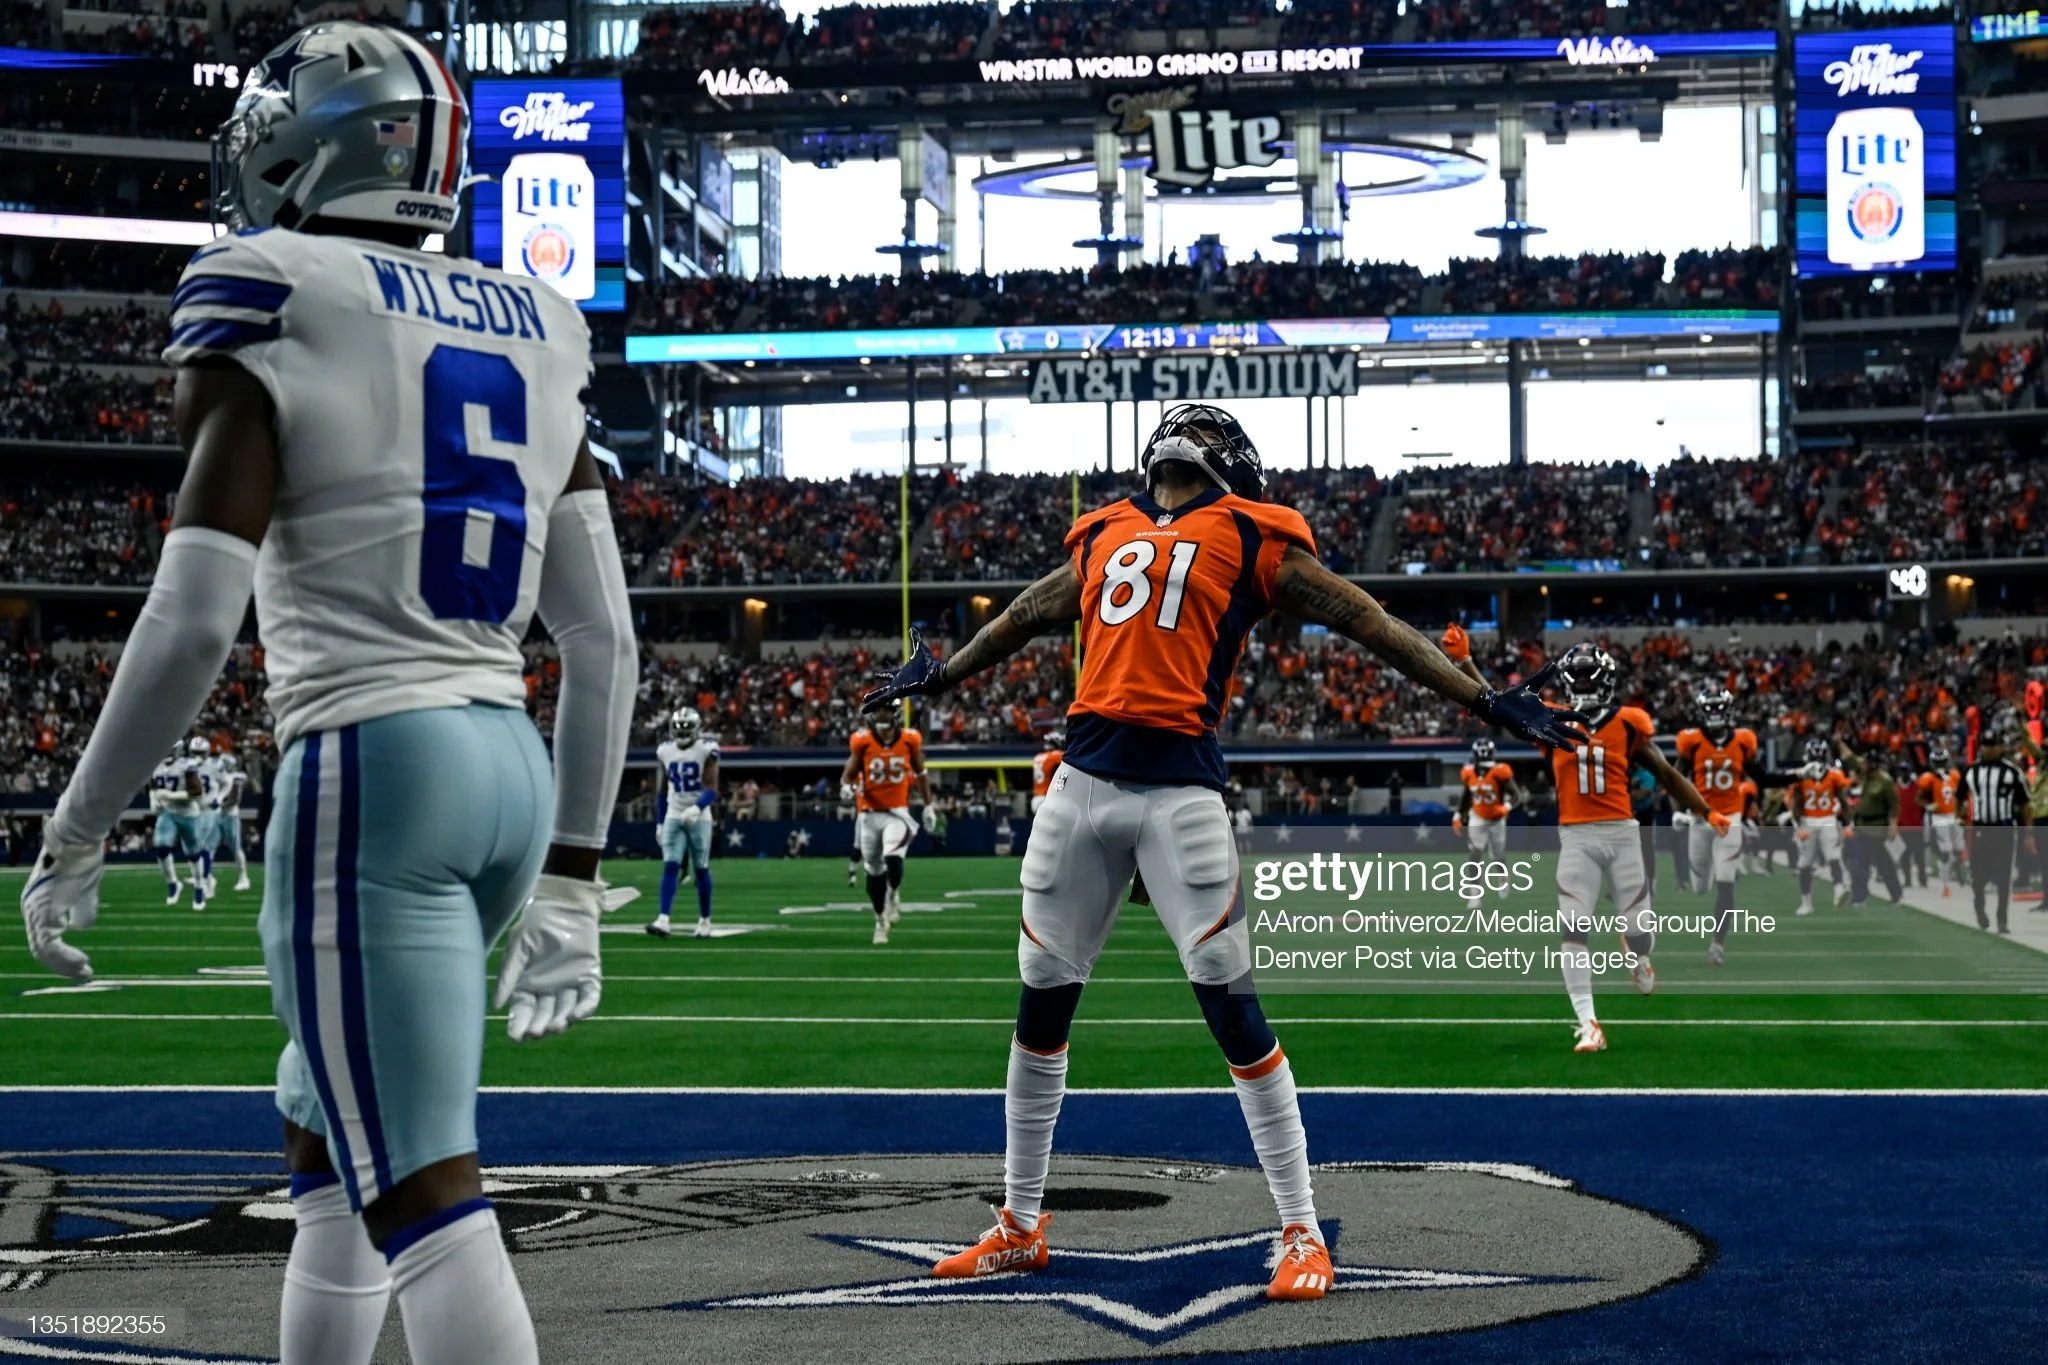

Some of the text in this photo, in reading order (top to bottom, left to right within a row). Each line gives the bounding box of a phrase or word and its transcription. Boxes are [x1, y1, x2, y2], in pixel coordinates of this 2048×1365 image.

[1980, 11, 2041, 41] TIME
[193, 63, 240, 89] IT'S
[979, 60, 1073, 82] WINSTAR
[1076, 56, 1153, 78] WORLD
[1157, 52, 1238, 76] CASINO
[1281, 47, 1364, 72] RESORT
[1144, 108, 1281, 186] Lite
[1841, 134, 1910, 175] Lite
[516, 177, 583, 216] Lite
[363, 254, 547, 342] WILSON
[1120, 327, 1176, 348] 12:13
[1030, 351, 1358, 402] AT&T STADIUM
[419, 342, 528, 626] 6
[1135, 530, 1180, 538] BRONCOS
[1098, 540, 1200, 632] 81
[1575, 744, 1606, 795] 11
[1703, 758, 1734, 791] 16
[1804, 789, 1832, 811] 26
